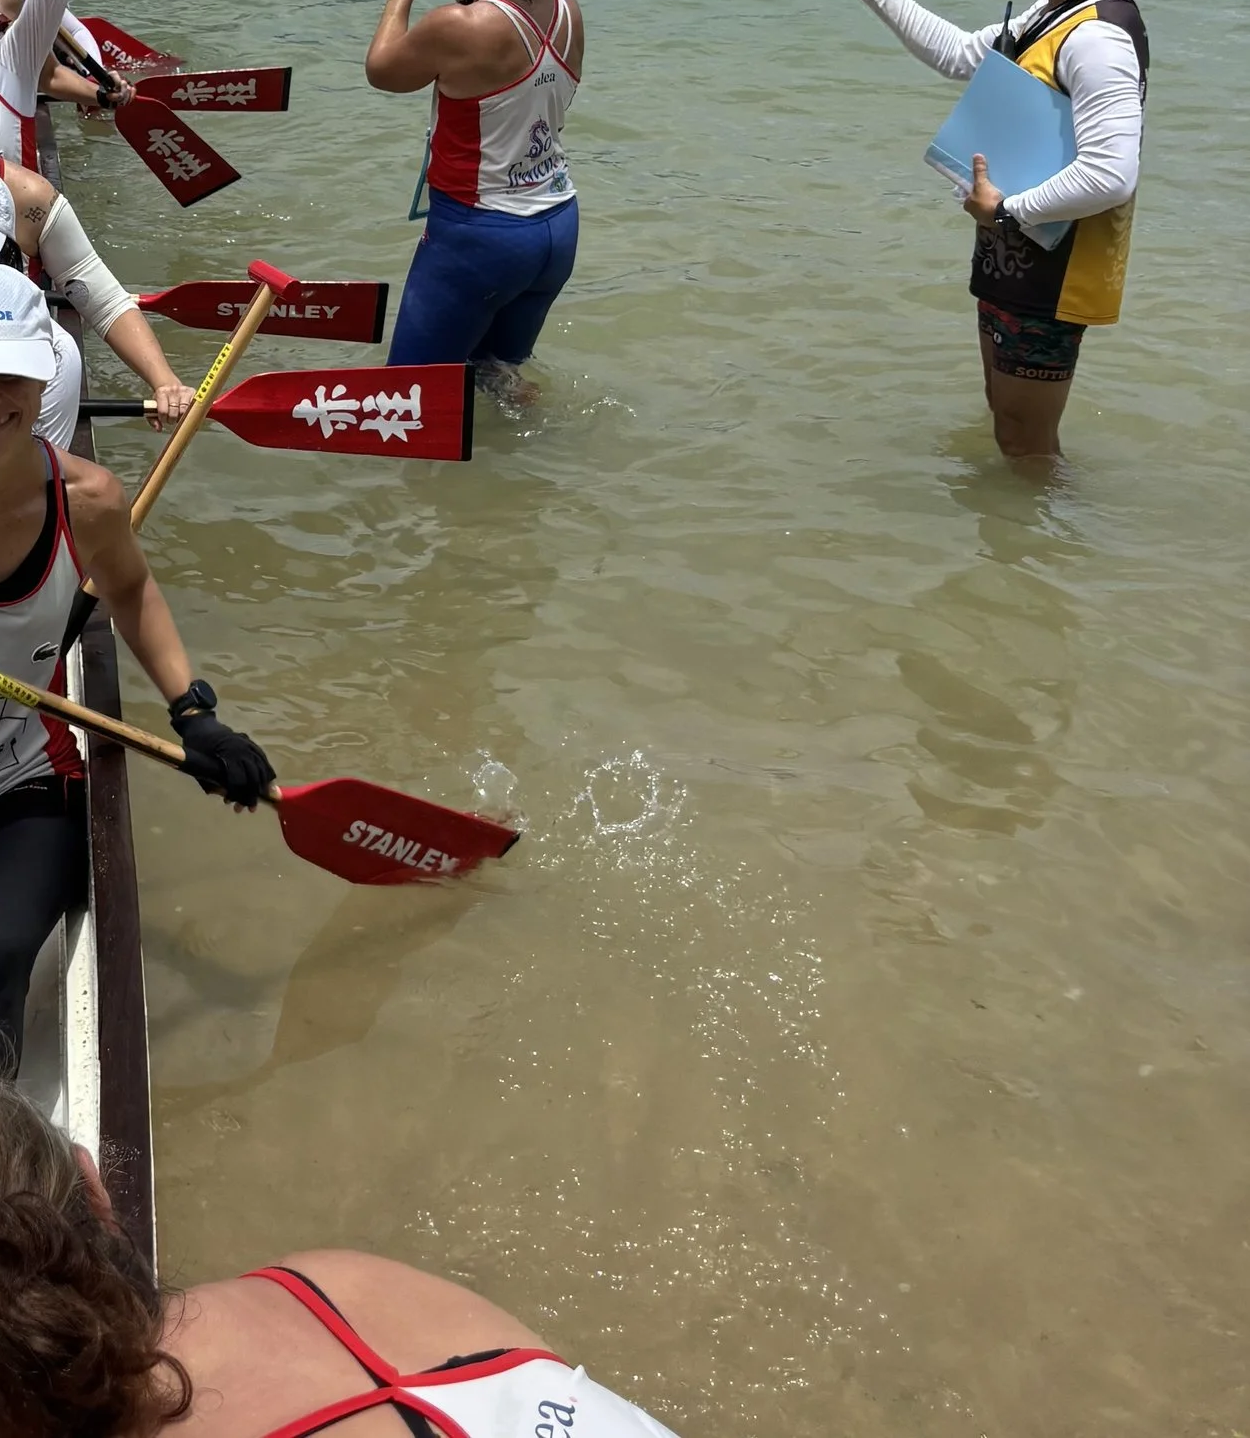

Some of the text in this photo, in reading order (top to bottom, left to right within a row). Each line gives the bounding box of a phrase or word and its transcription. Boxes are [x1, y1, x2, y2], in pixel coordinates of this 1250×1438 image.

[171, 78, 257, 106] 赤柱
[534, 72, 556, 87] alea
[147, 129, 211, 181] 赤柱
[217, 302, 341, 320] STNLEY
[292, 384, 424, 442] 赤柱
[342, 820, 460, 873] STANLEY
